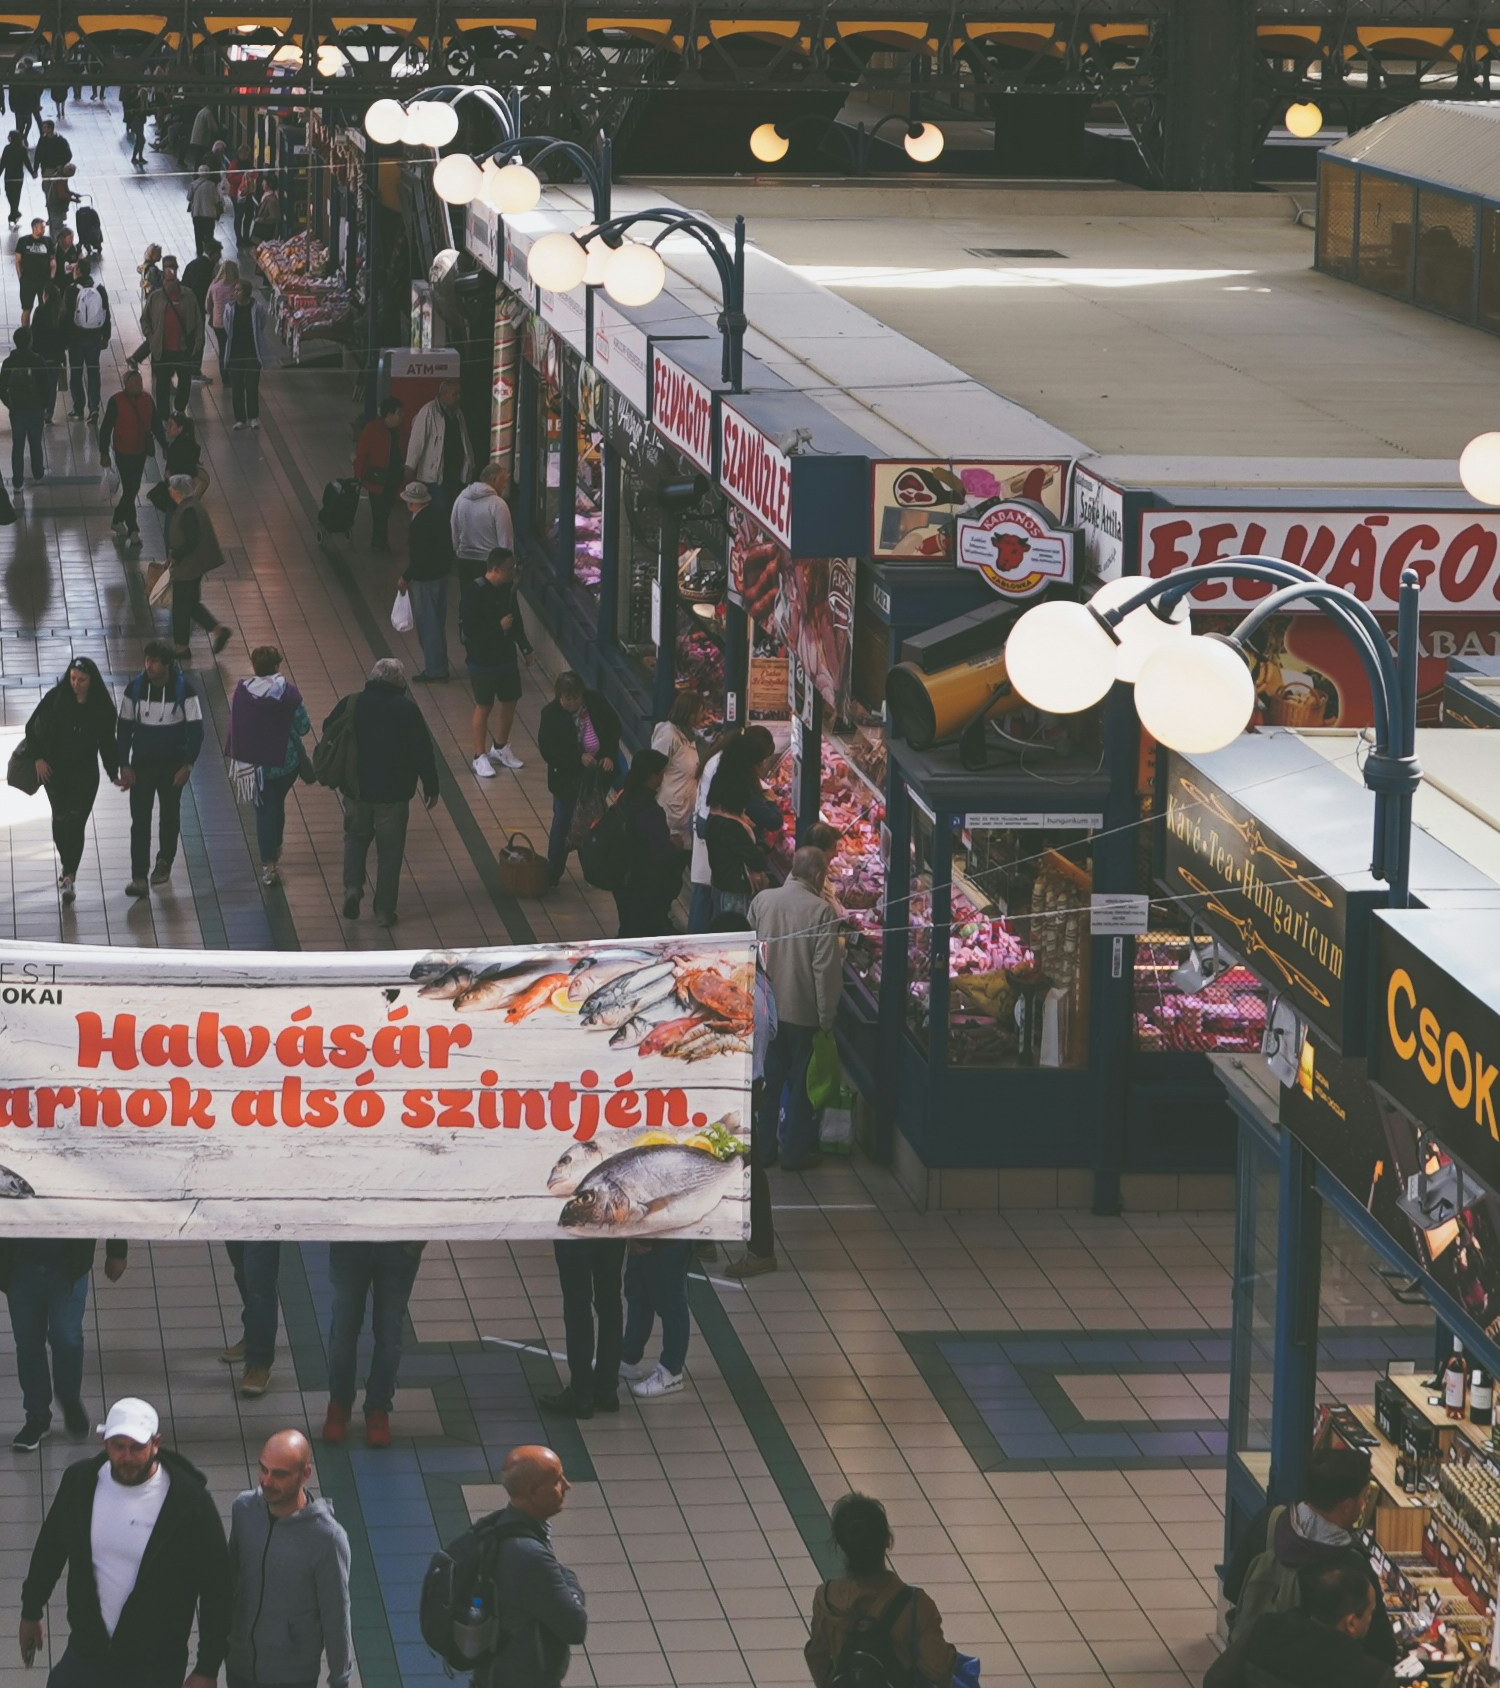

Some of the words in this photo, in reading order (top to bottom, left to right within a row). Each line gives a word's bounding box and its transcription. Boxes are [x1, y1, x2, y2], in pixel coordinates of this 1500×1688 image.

[407, 364, 434, 375] ATM
[1101, 504, 1122, 541] Attila
[1166, 793, 1201, 853] Kávé
[1209, 830, 1234, 884] Tea
[1242, 858, 1344, 981] Hungaricum
[76, 1005, 473, 1071] Halvásár
[231, 1071, 397, 1129] alsó
[402, 1068, 707, 1142] szintjén.
